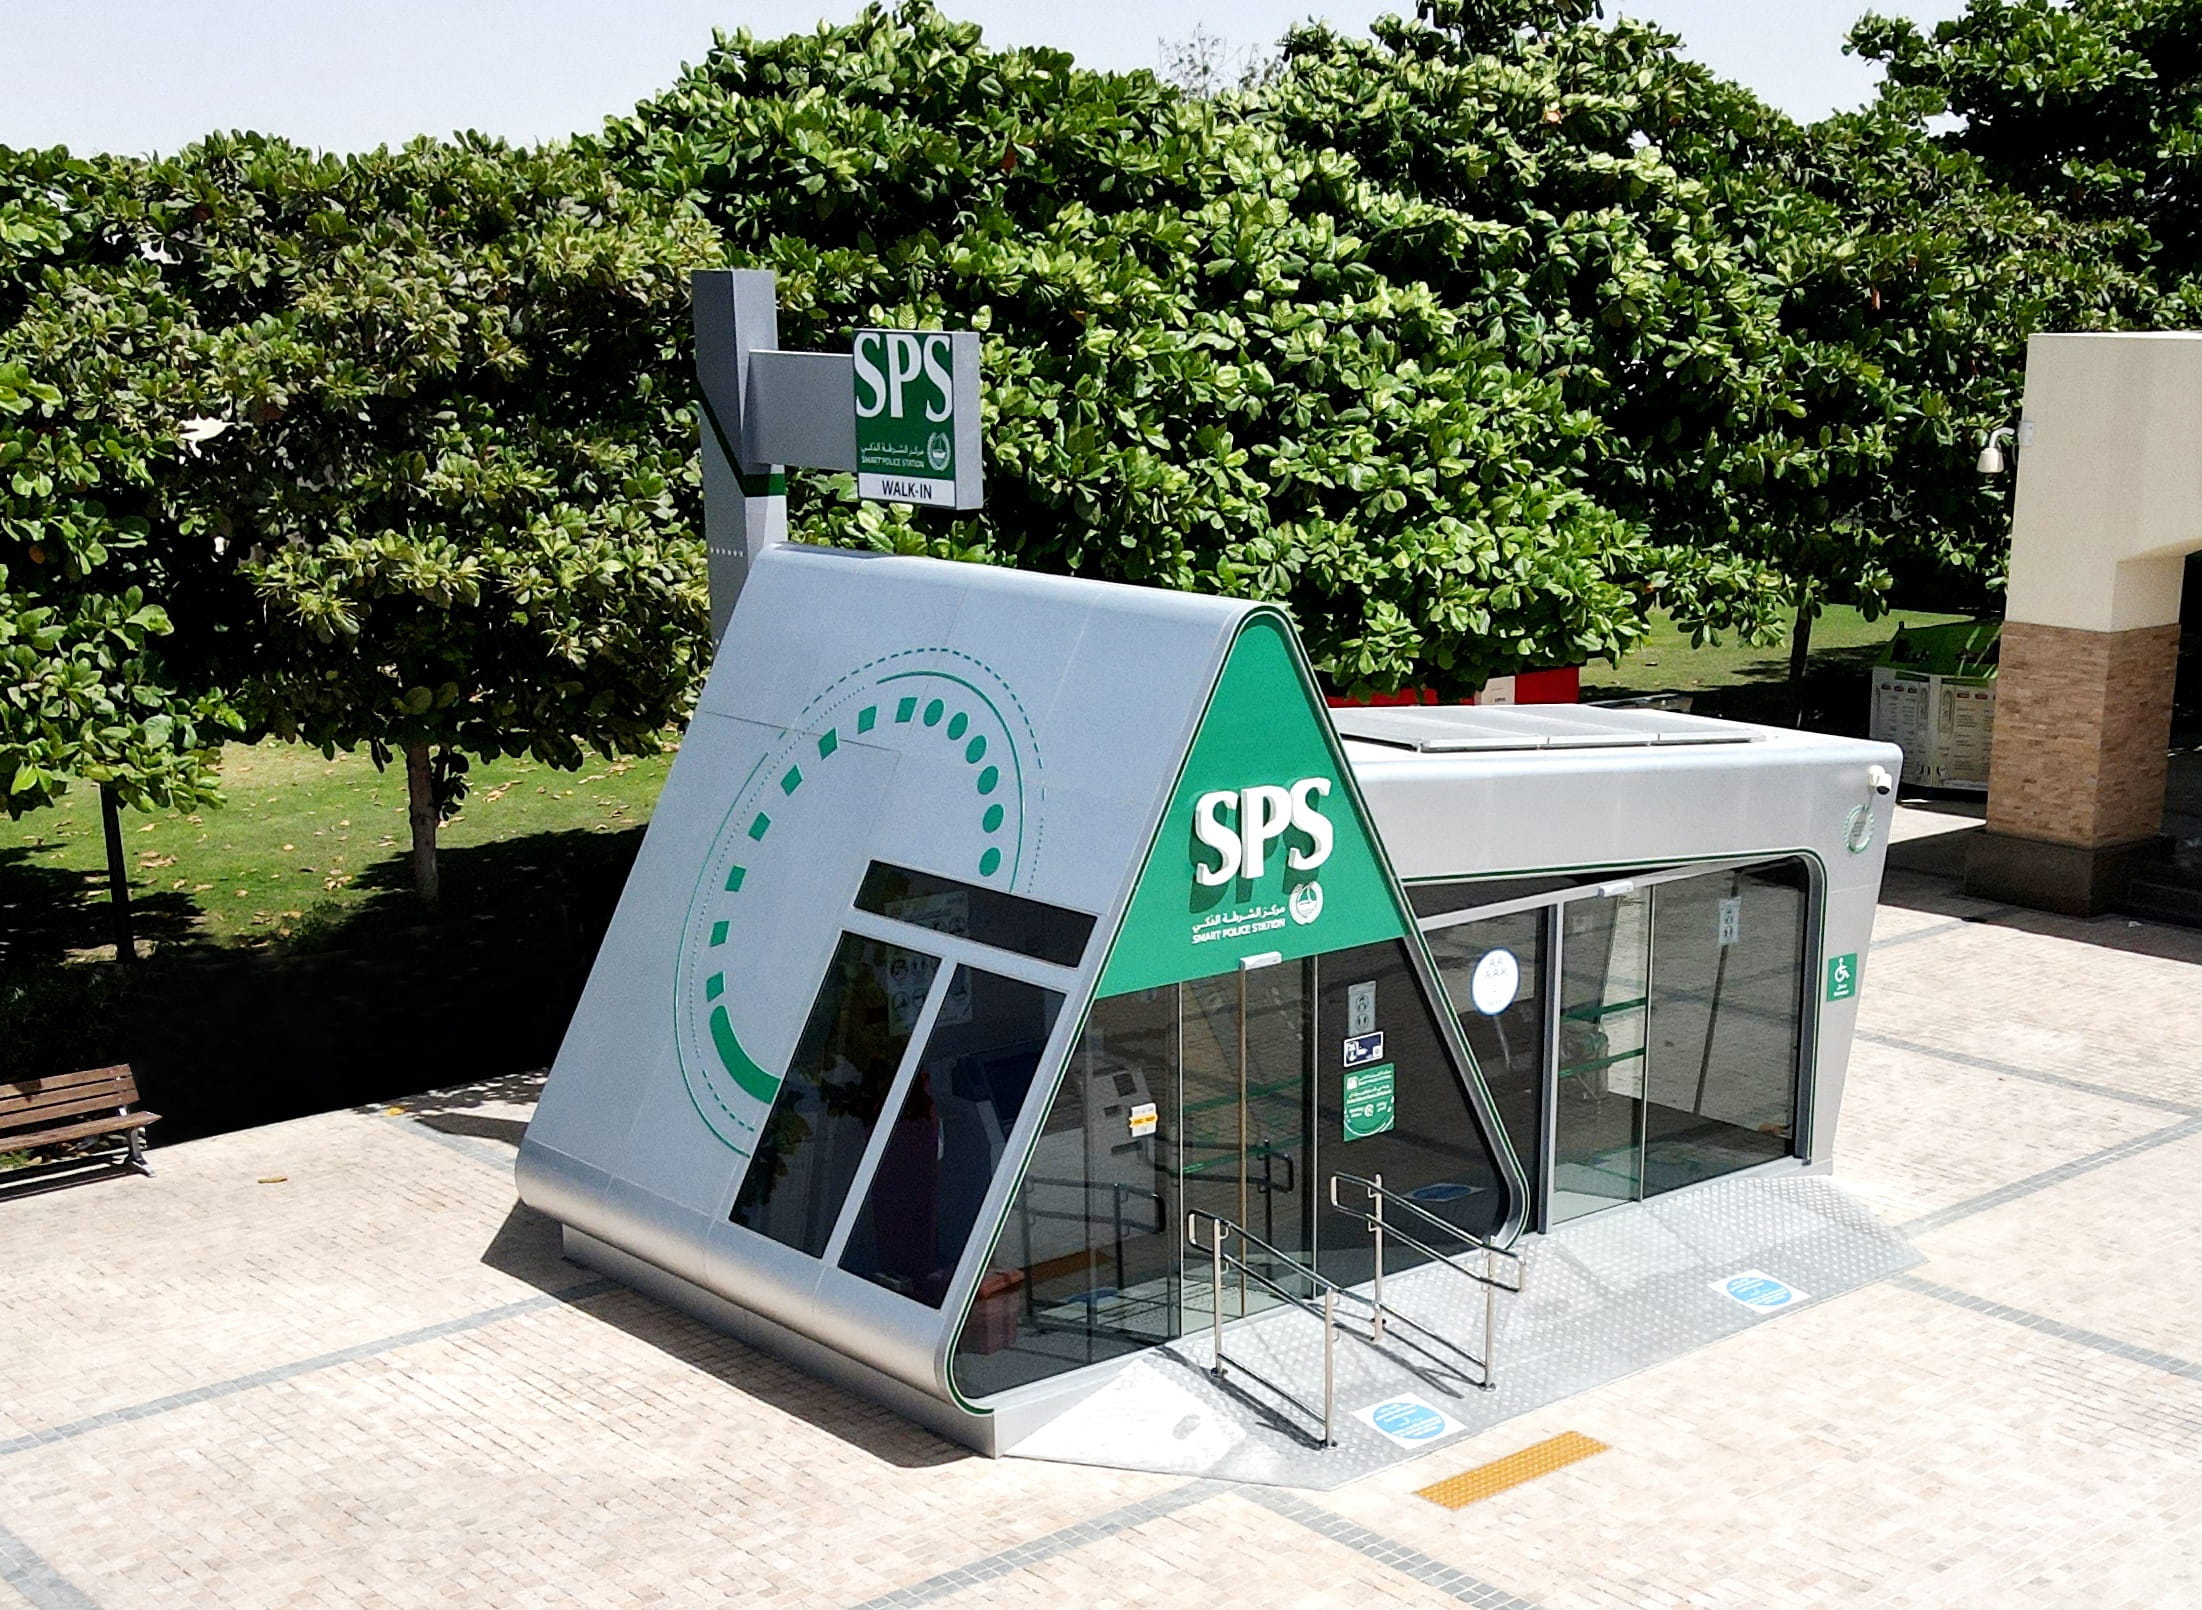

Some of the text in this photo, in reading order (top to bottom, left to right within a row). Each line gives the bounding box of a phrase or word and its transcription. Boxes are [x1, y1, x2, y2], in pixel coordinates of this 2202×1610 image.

[854, 332, 952, 422] SPS
[882, 457, 901, 467] POLICE
[902, 459, 924, 468] STATION
[882, 480, 932, 499] WALK-IN
[1195, 777, 1333, 886] SPS
[1192, 918, 1286, 944] SMART POLICE STATION
